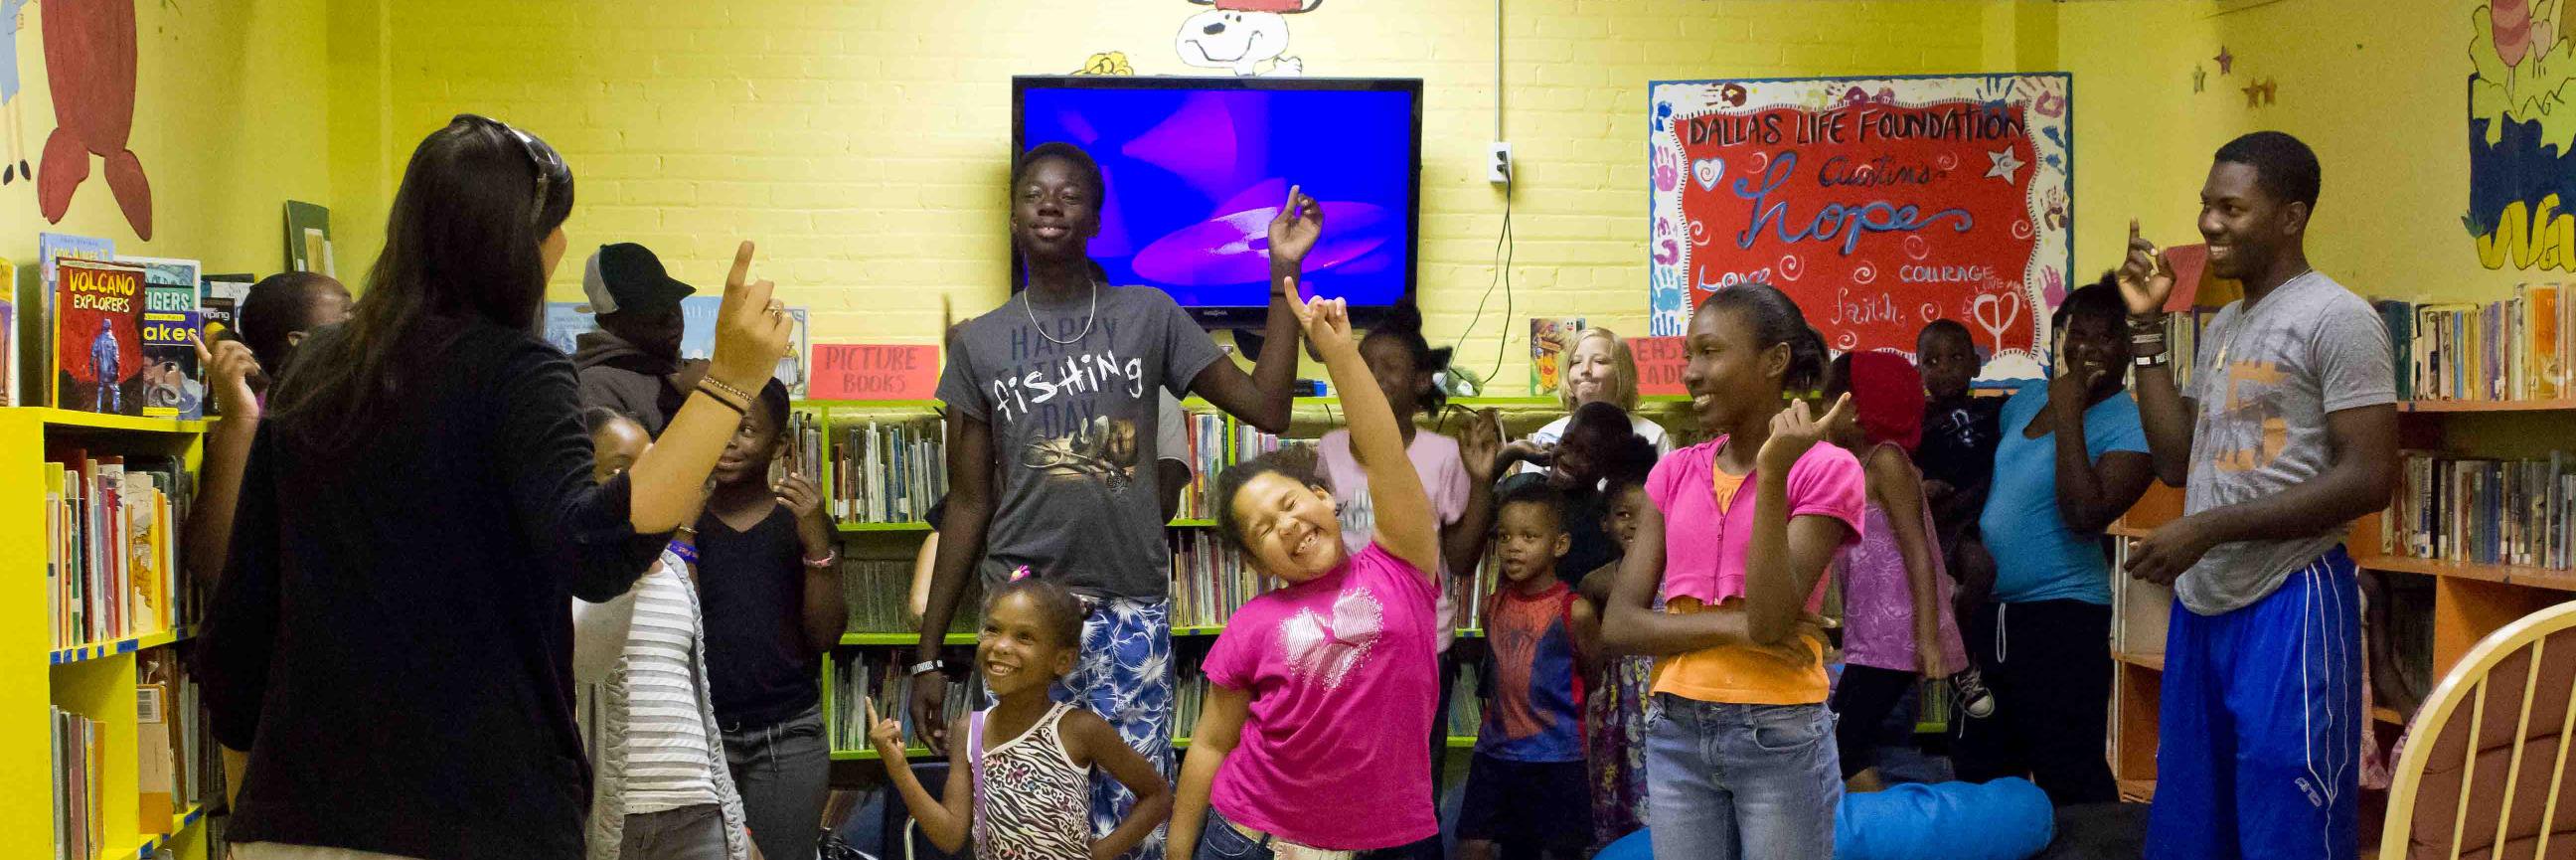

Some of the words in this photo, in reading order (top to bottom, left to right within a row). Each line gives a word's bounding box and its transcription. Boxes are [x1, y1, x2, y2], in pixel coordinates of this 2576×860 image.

[1688, 112, 1783, 146] DALLAS
[1796, 110, 1846, 145] LIFE
[1858, 107, 2027, 143] FOUNDATION
[69, 269, 136, 296] VOLCANO
[1899, 263, 1996, 282] COURAGE
[74, 293, 130, 313] EXPLORERS
[144, 291, 190, 312] IGERS
[1011, 316, 1120, 361] HAPPY
[826, 346, 919, 371] PICTURE
[844, 373, 906, 394] BOOKS
